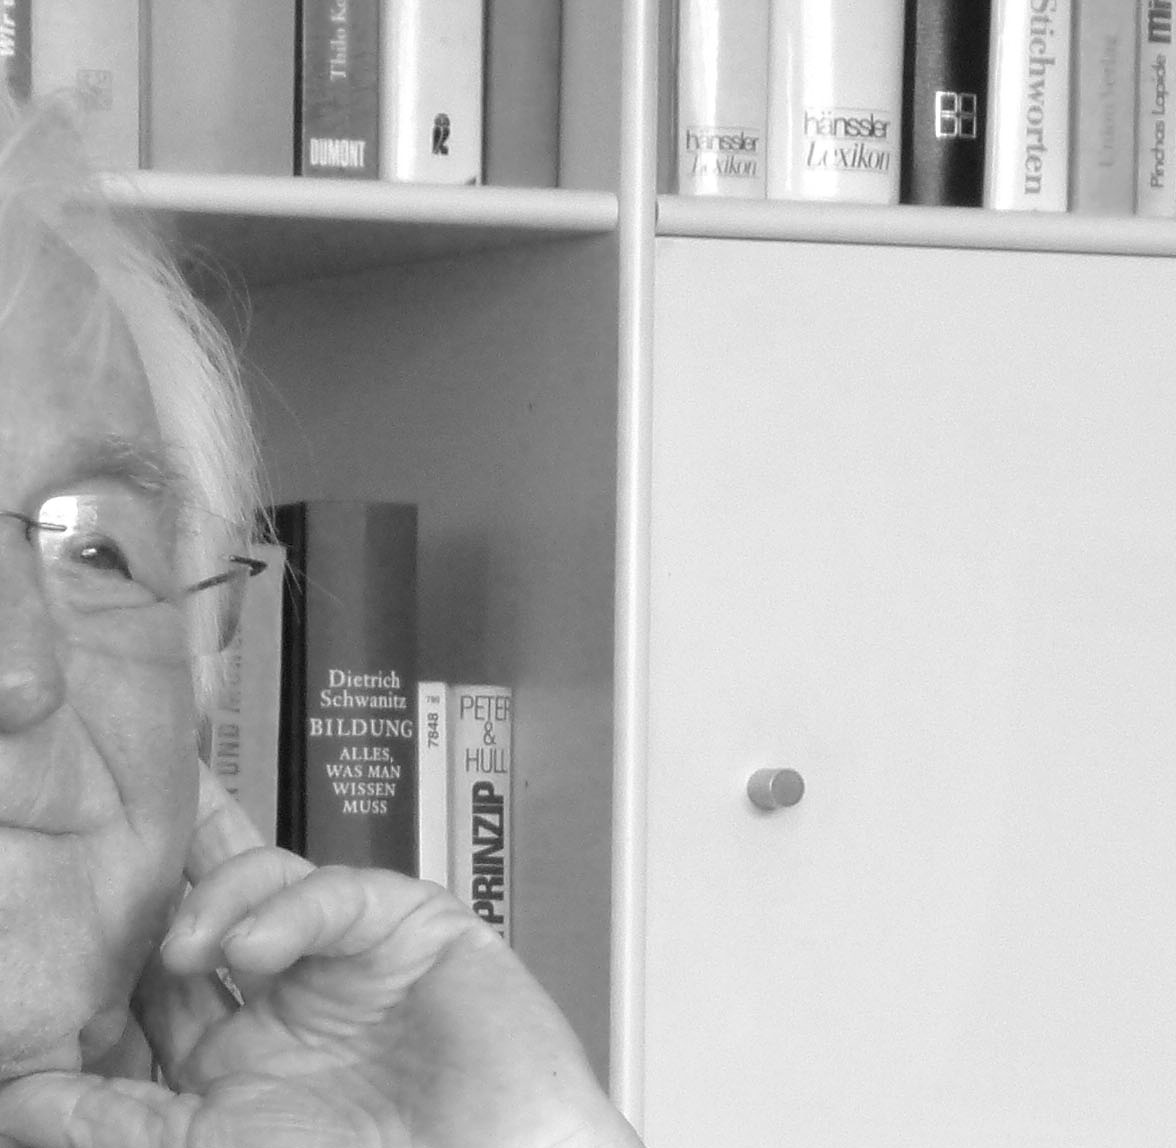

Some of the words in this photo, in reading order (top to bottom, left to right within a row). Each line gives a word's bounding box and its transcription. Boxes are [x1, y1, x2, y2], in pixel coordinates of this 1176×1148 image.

[330, 28, 347, 80] Thilo
[1024, 0, 1056, 195] Stichworten
[1150, 54, 1169, 115] Lapide
[804, 110, 890, 138] hänssler
[310, 138, 366, 168] DUMONT
[1150, 120, 1166, 188] Pinchas
[329, 669, 400, 689] Dietrich
[320, 689, 407, 709] Schwanitz
[460, 695, 510, 721] PETER
[309, 717, 413, 738] BILDUNG
[427, 712, 440, 748] 7848
[483, 720, 496, 745] &
[339, 746, 394, 763] ALLES,
[465, 748, 508, 774] HULL
[326, 763, 363, 778] WAS
[367, 764, 401, 779] MAN
[332, 781, 396, 796] WISSEN
[342, 799, 388, 814] MUSS
[472, 780, 506, 924] PRINZIP
